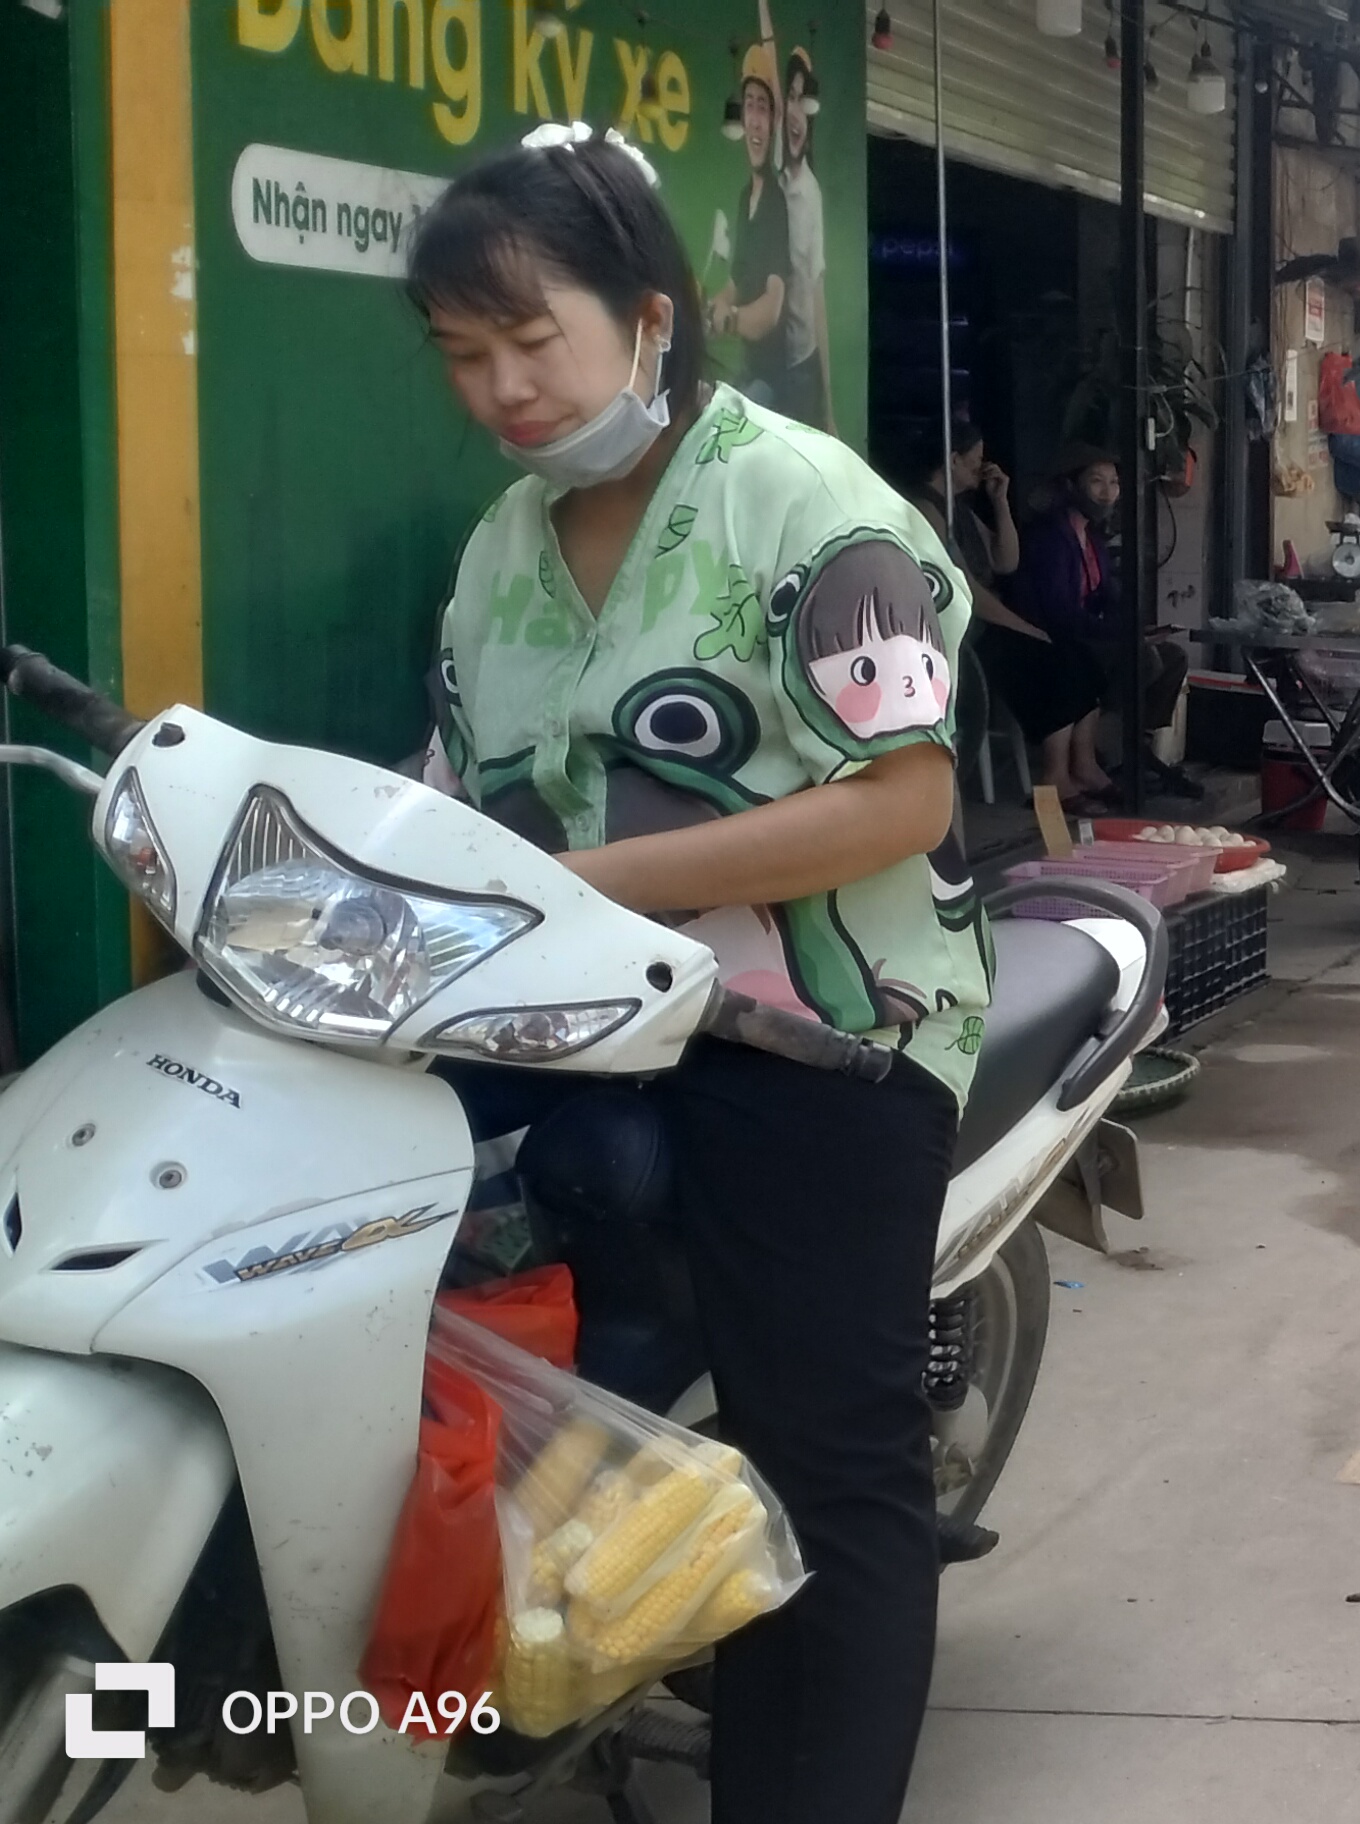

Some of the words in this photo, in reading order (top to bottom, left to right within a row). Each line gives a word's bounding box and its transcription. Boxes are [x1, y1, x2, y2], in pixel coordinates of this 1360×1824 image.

[613, 38, 690, 151] xe
[252, 178, 326, 243] Nhận
[337, 203, 402, 253] ngay
[146, 1054, 240, 1108] HONDA
